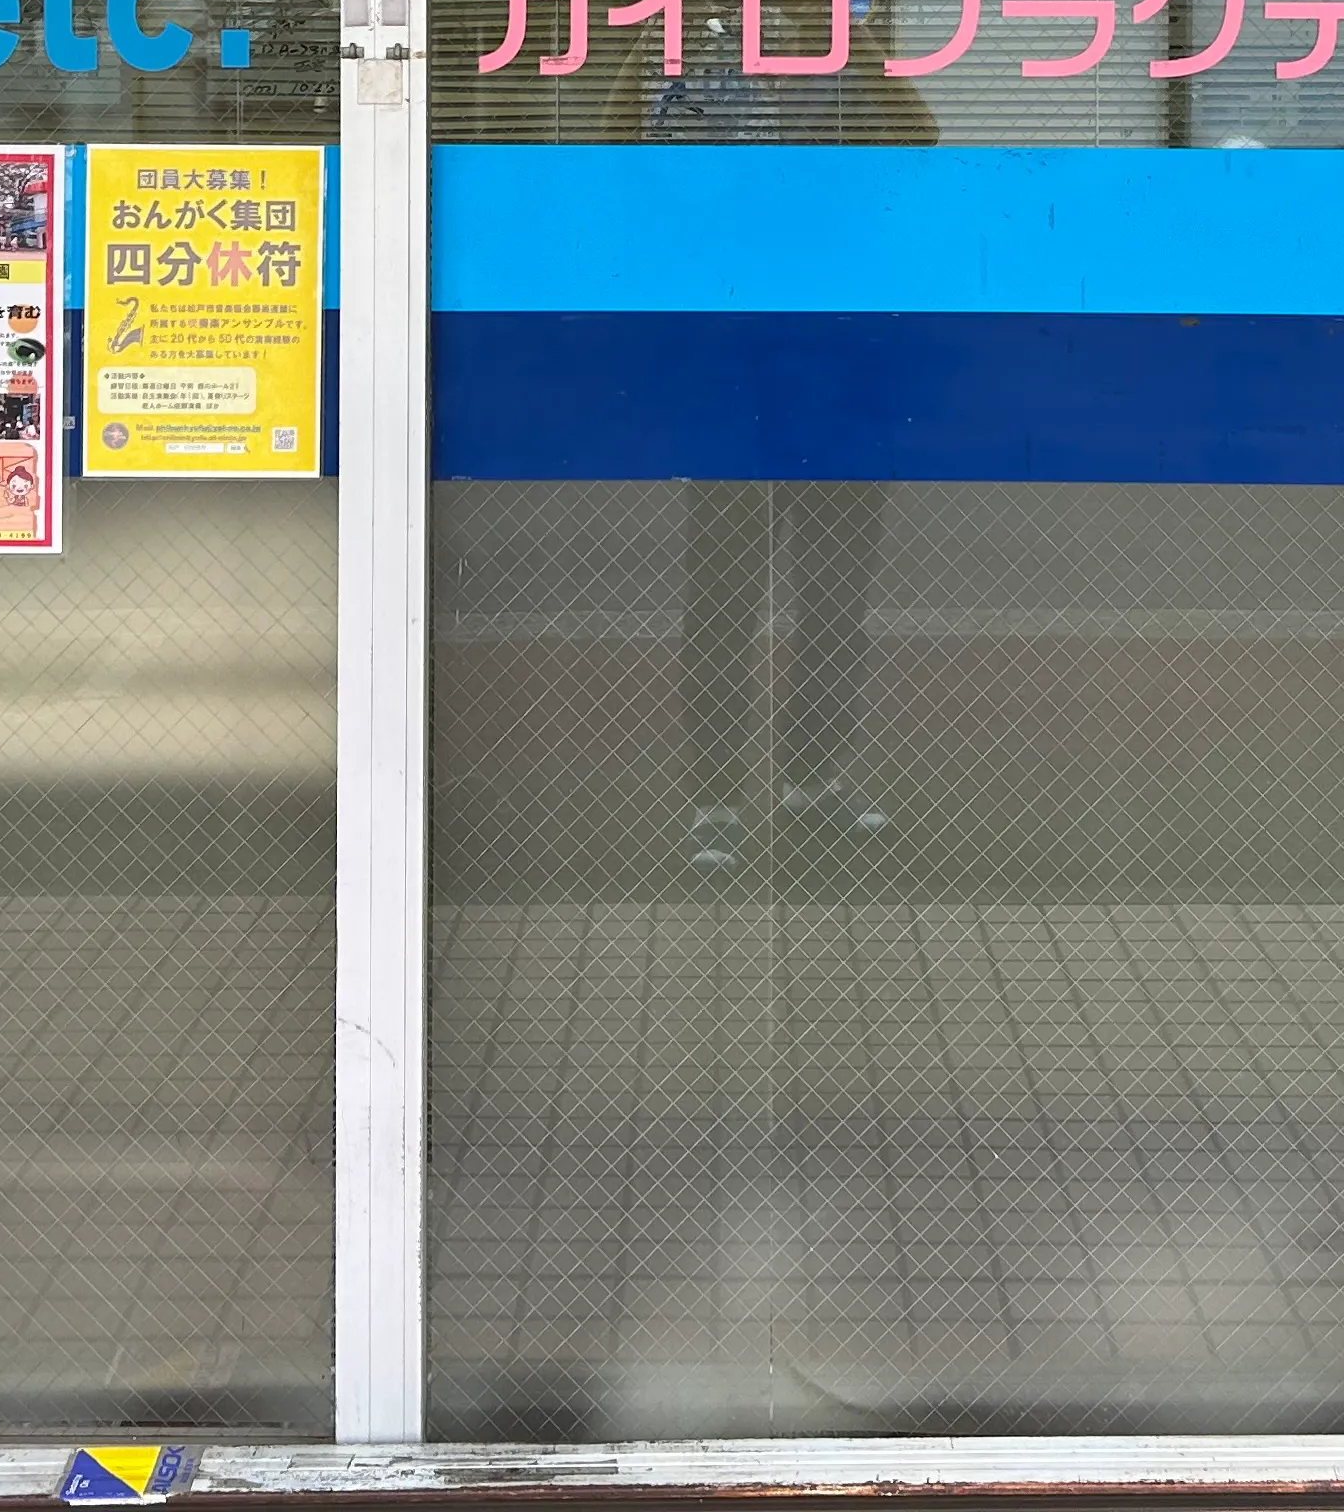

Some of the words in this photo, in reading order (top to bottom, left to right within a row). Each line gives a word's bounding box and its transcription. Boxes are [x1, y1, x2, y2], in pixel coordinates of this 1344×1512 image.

[137, 168, 267, 191] 団員大募集!
[112, 199, 296, 232] おんがく集団
[106, 241, 302, 287] 四分休符
